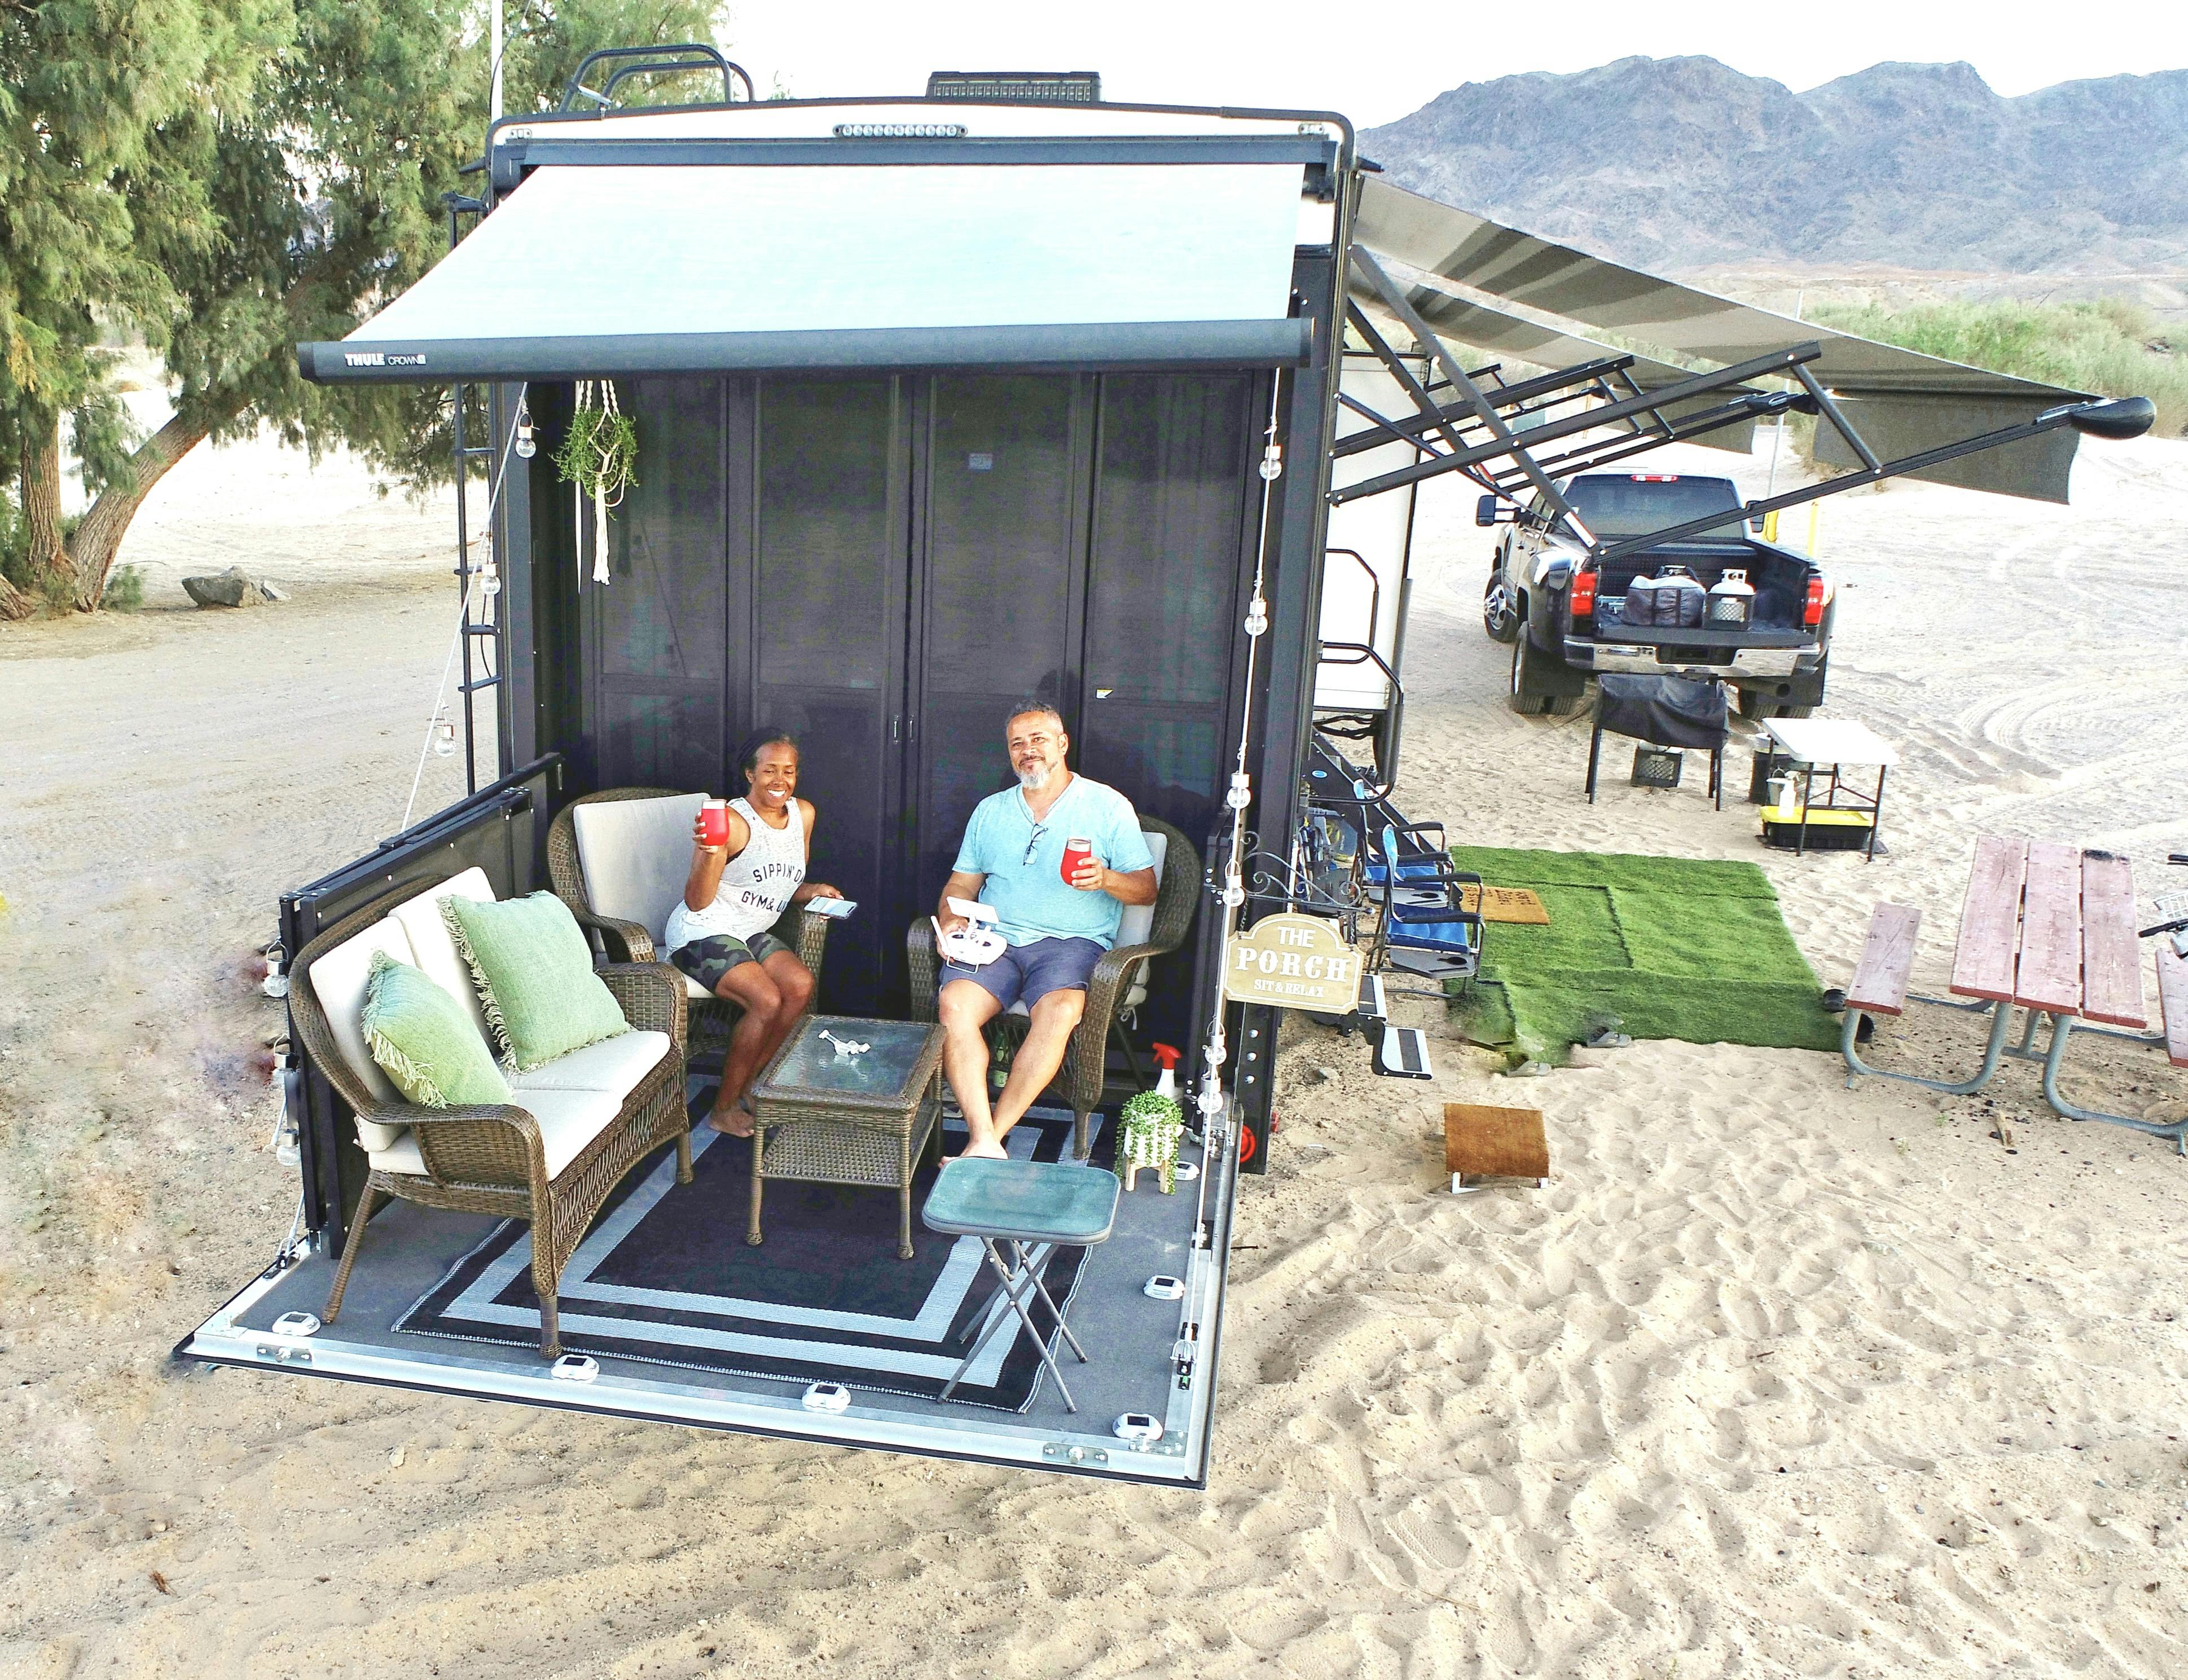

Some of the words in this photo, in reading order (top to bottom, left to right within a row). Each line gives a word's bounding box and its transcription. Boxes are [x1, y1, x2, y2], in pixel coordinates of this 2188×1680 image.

[345, 353, 385, 366] THULE
[753, 863, 795, 882] SIPPIN'
[1277, 926, 1316, 948] THE
[1235, 947, 1350, 982] PORCH
[1254, 979, 1275, 991] SIT
[1285, 982, 1325, 997] RELAX
